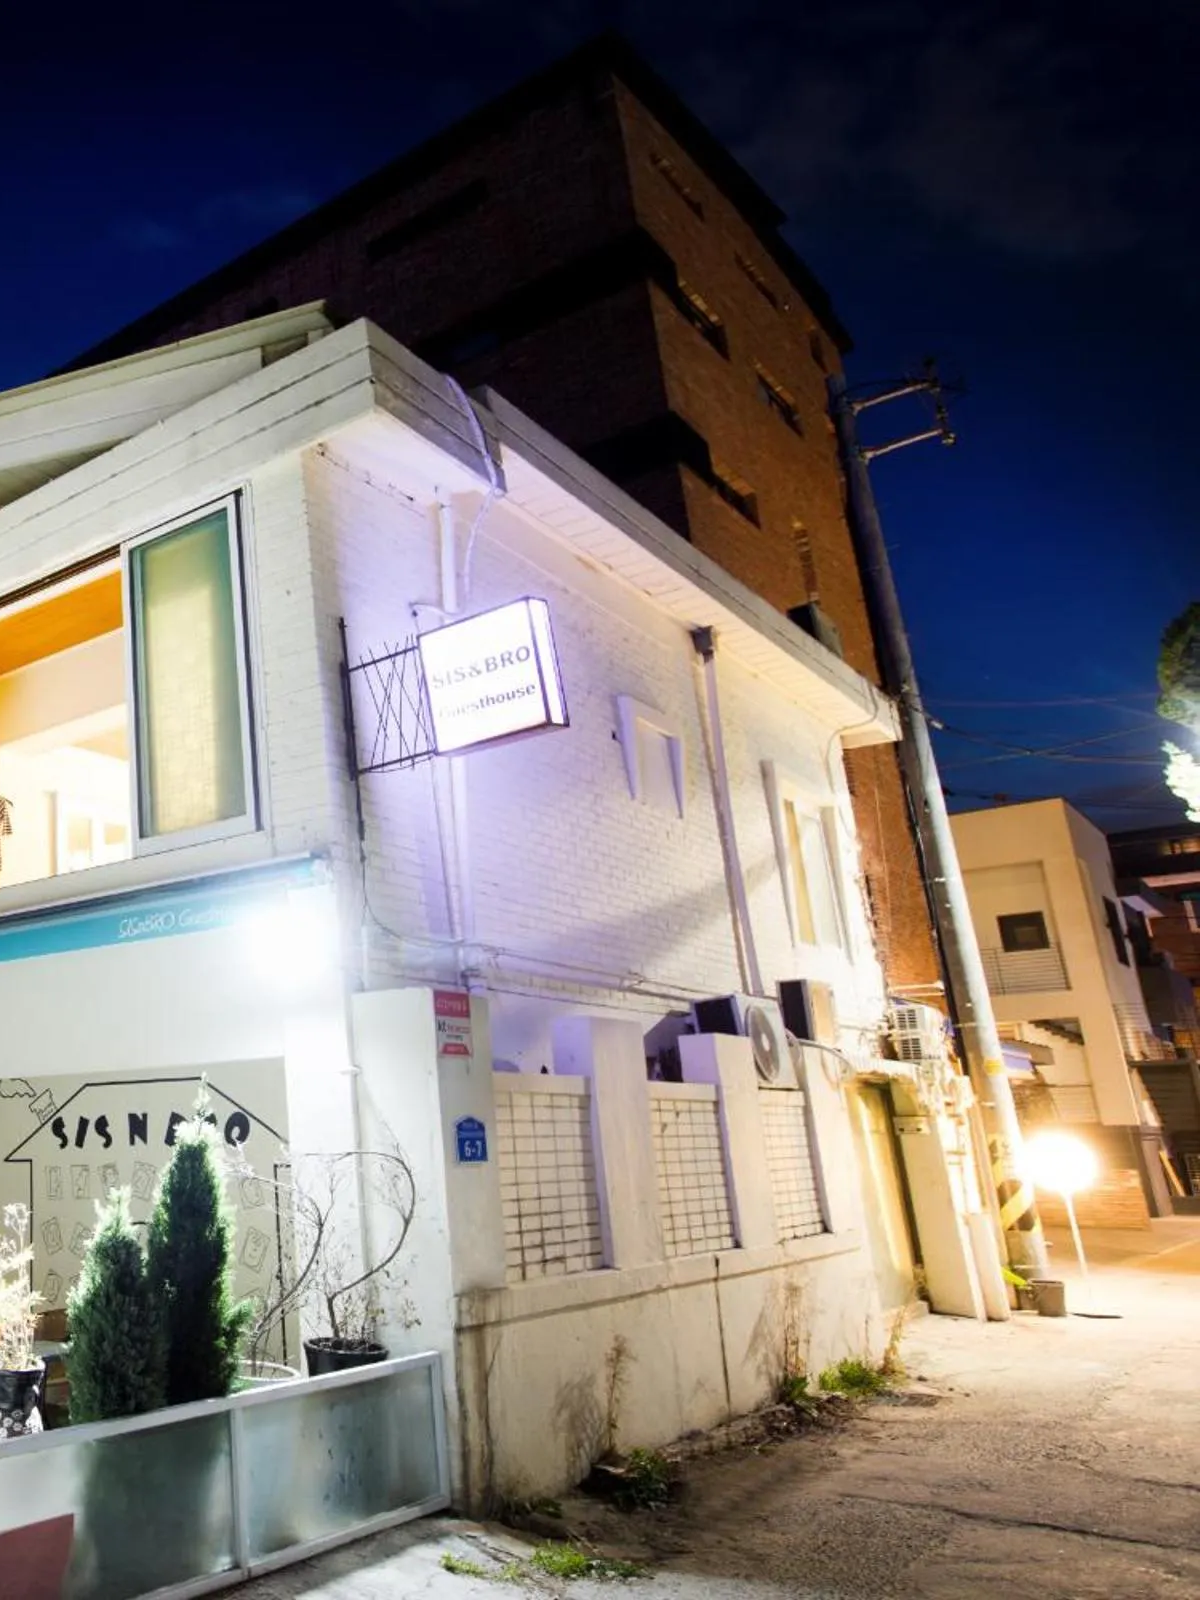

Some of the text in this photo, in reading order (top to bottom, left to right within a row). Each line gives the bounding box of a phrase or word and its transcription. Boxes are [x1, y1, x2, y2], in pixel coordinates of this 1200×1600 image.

[432, 645, 531, 690] SIS&BRO
[52, 1111, 250, 1149] SIS N BO
